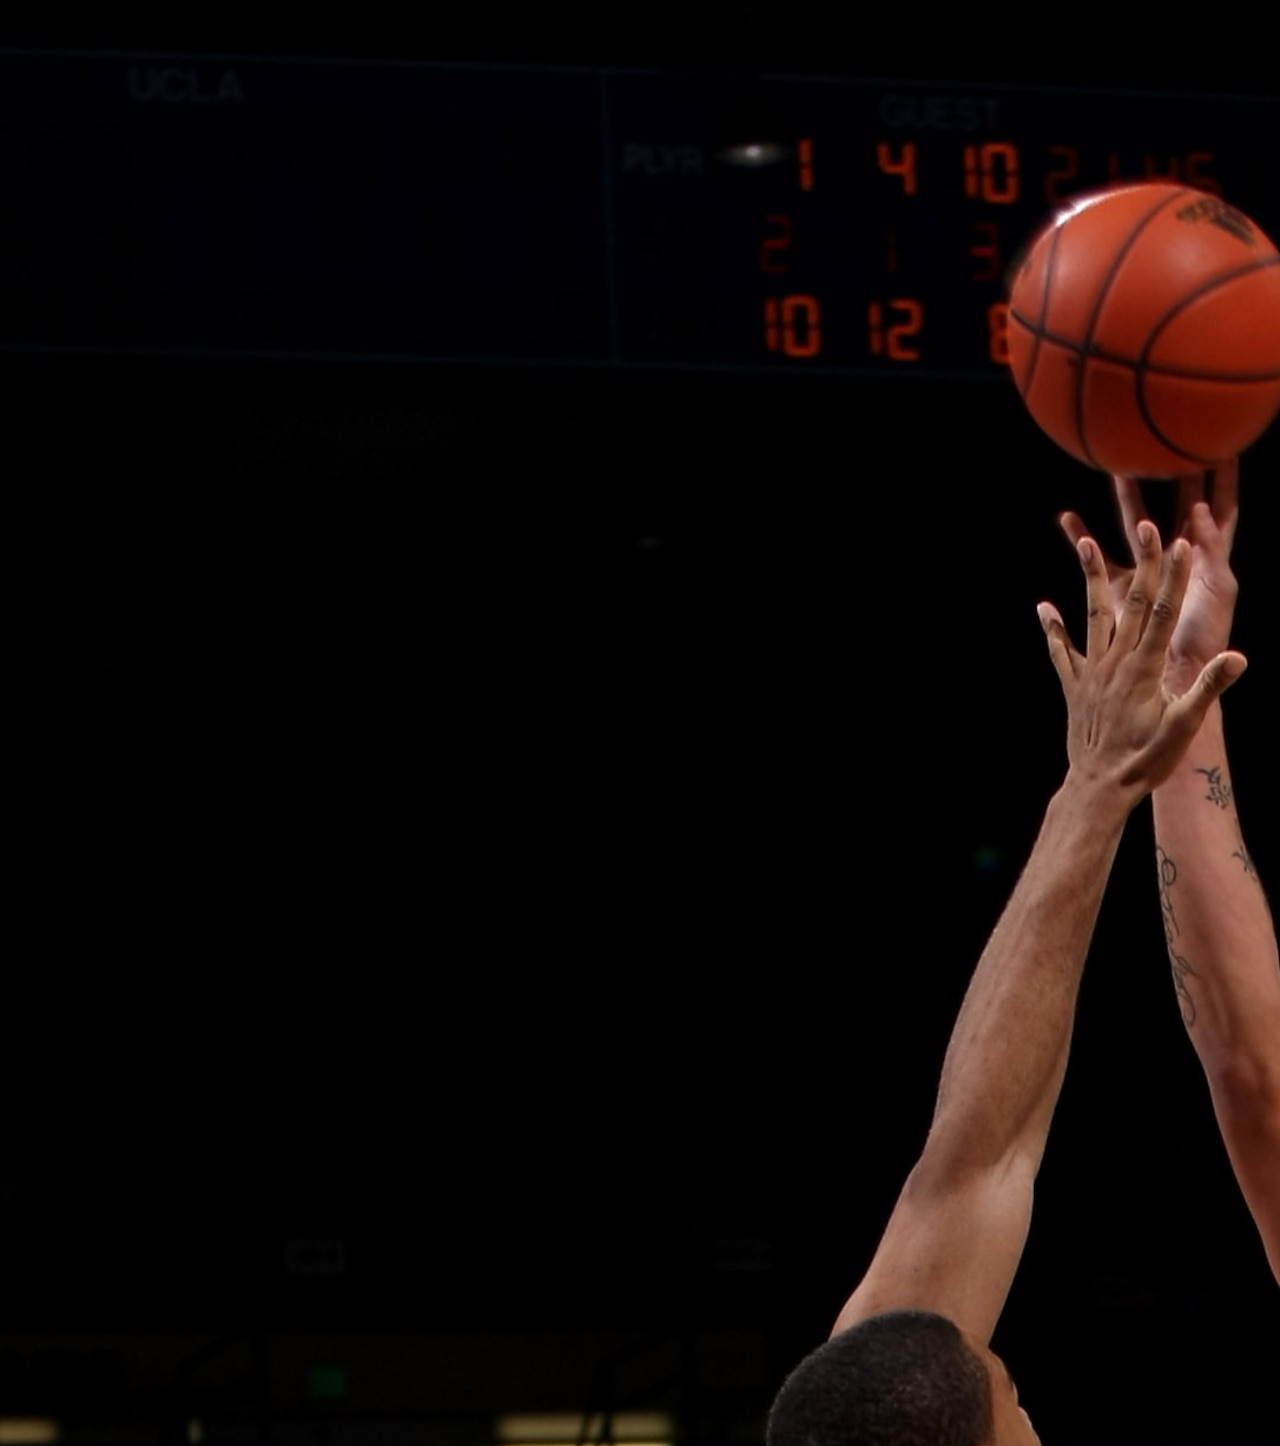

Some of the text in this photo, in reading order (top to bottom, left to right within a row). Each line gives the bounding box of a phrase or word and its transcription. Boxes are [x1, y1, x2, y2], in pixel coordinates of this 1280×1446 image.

[127, 67, 246, 105] UCLA
[879, 93, 1000, 131] GUEST
[797, 137, 816, 192] 1
[874, 140, 918, 197] 4
[961, 140, 1021, 206] 10
[759, 212, 794, 275] 2
[763, 293, 823, 359] 10
[866, 297, 924, 363] 12
